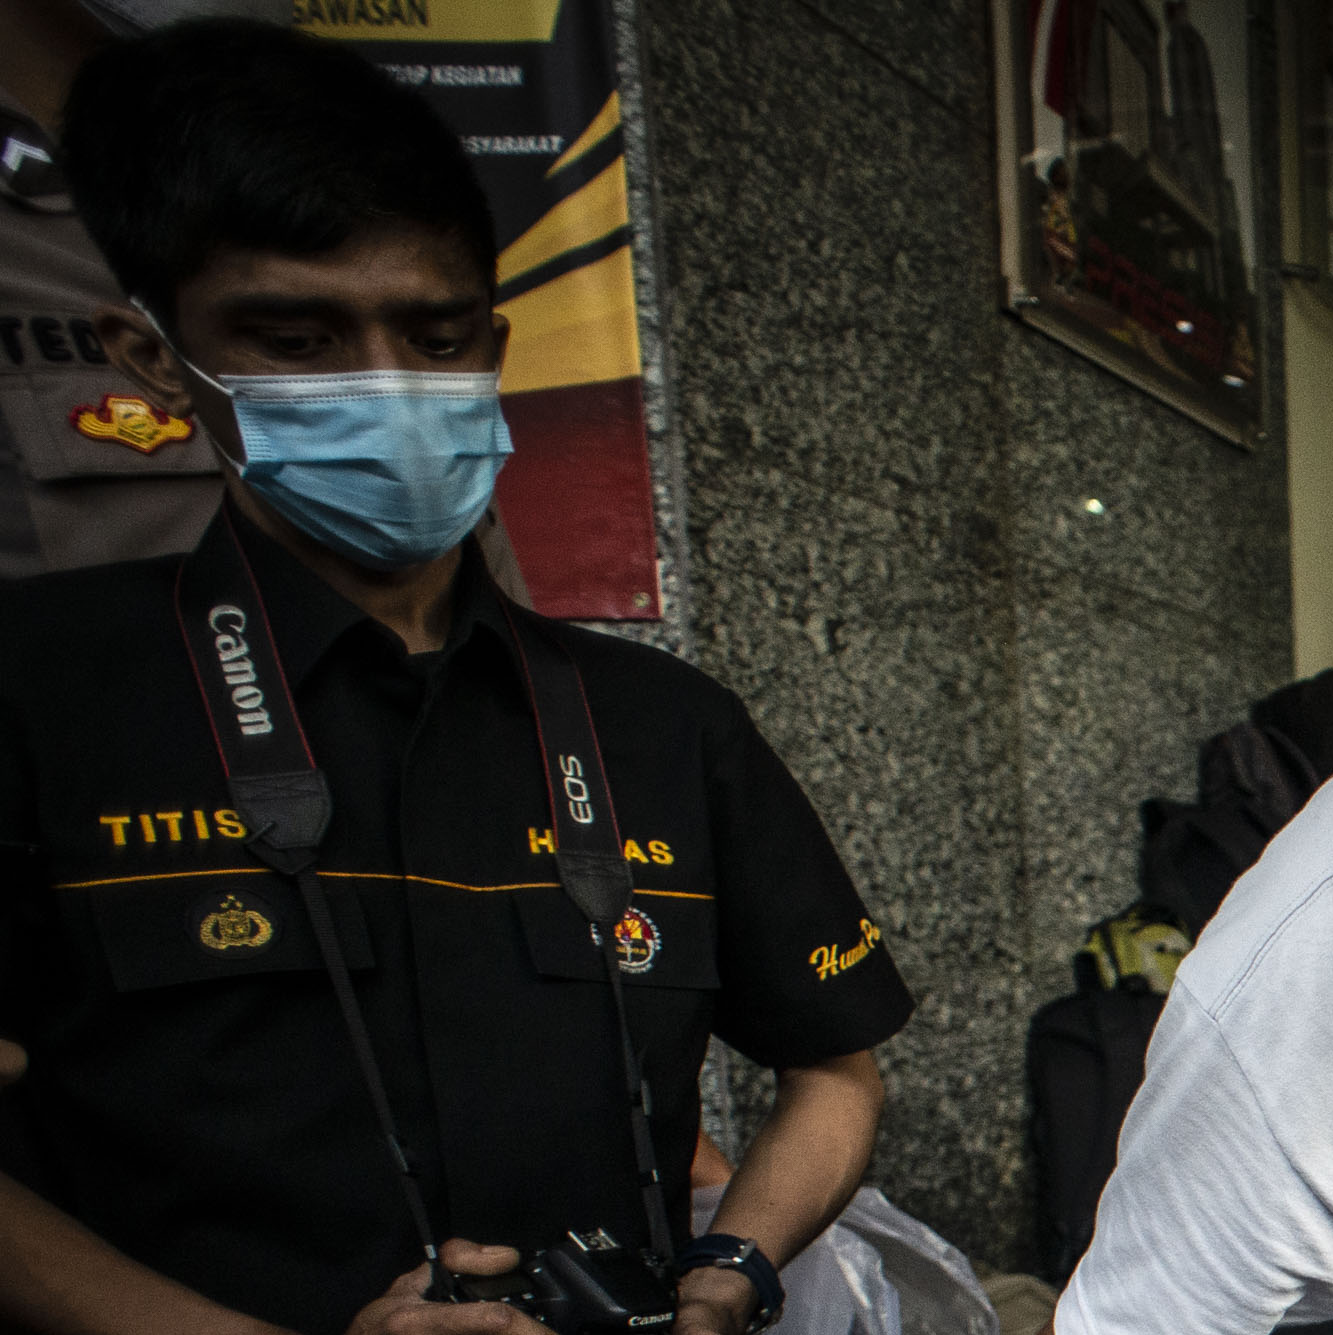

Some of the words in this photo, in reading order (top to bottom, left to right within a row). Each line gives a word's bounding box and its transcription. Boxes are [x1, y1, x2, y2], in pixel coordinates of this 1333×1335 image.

[207, 604, 273, 737] Canon
[560, 755, 595, 825] EOS
[527, 827, 675, 867] HAS
